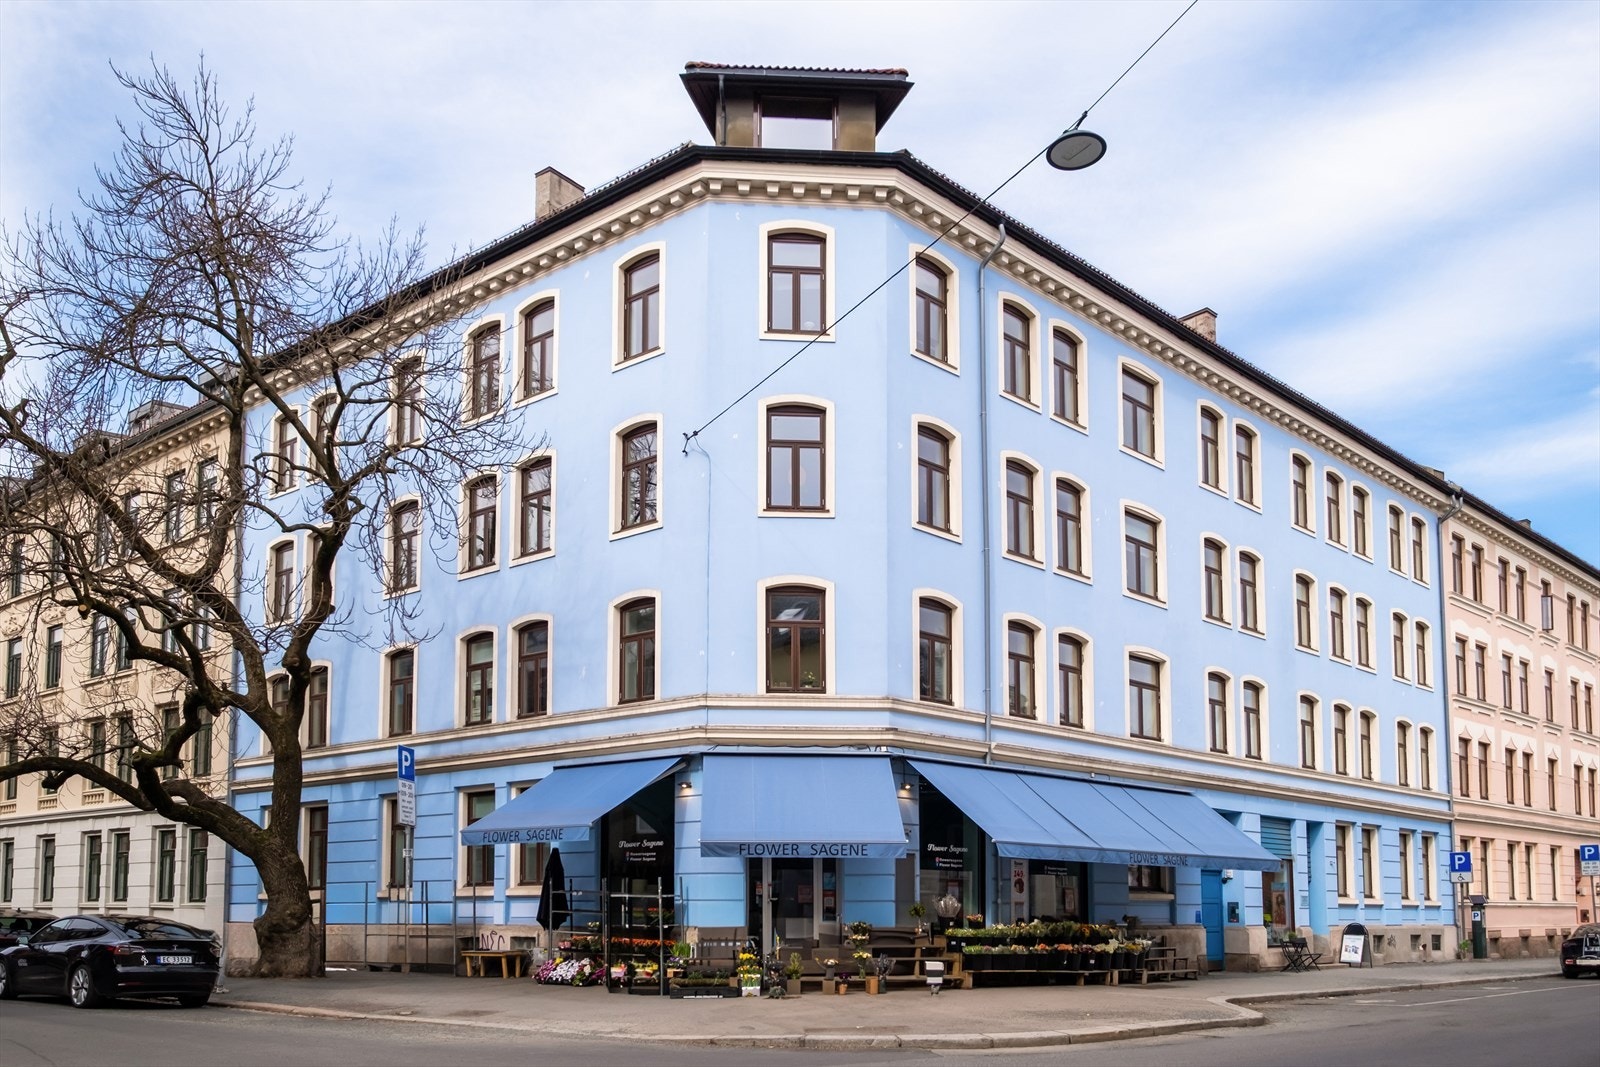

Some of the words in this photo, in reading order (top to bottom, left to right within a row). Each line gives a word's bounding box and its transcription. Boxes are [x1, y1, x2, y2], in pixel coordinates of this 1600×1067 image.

[402, 750, 411, 775] P
[482, 830, 520, 843] FLOWER
[526, 828, 564, 841] SAGENE
[618, 840, 640, 848] Flower
[641, 839, 664, 849] Sagene
[739, 843, 800, 856] FLOWER
[810, 843, 868, 856] SAGENE
[927, 843, 948, 851] Flower
[948, 844, 969, 854] Sagene
[1129, 852, 1159, 864] FLOWER
[1162, 855, 1189, 866] SAGENE
[1585, 846, 1595, 859] P
[1454, 854, 1466, 870] P
[1473, 912, 1480, 920] P
